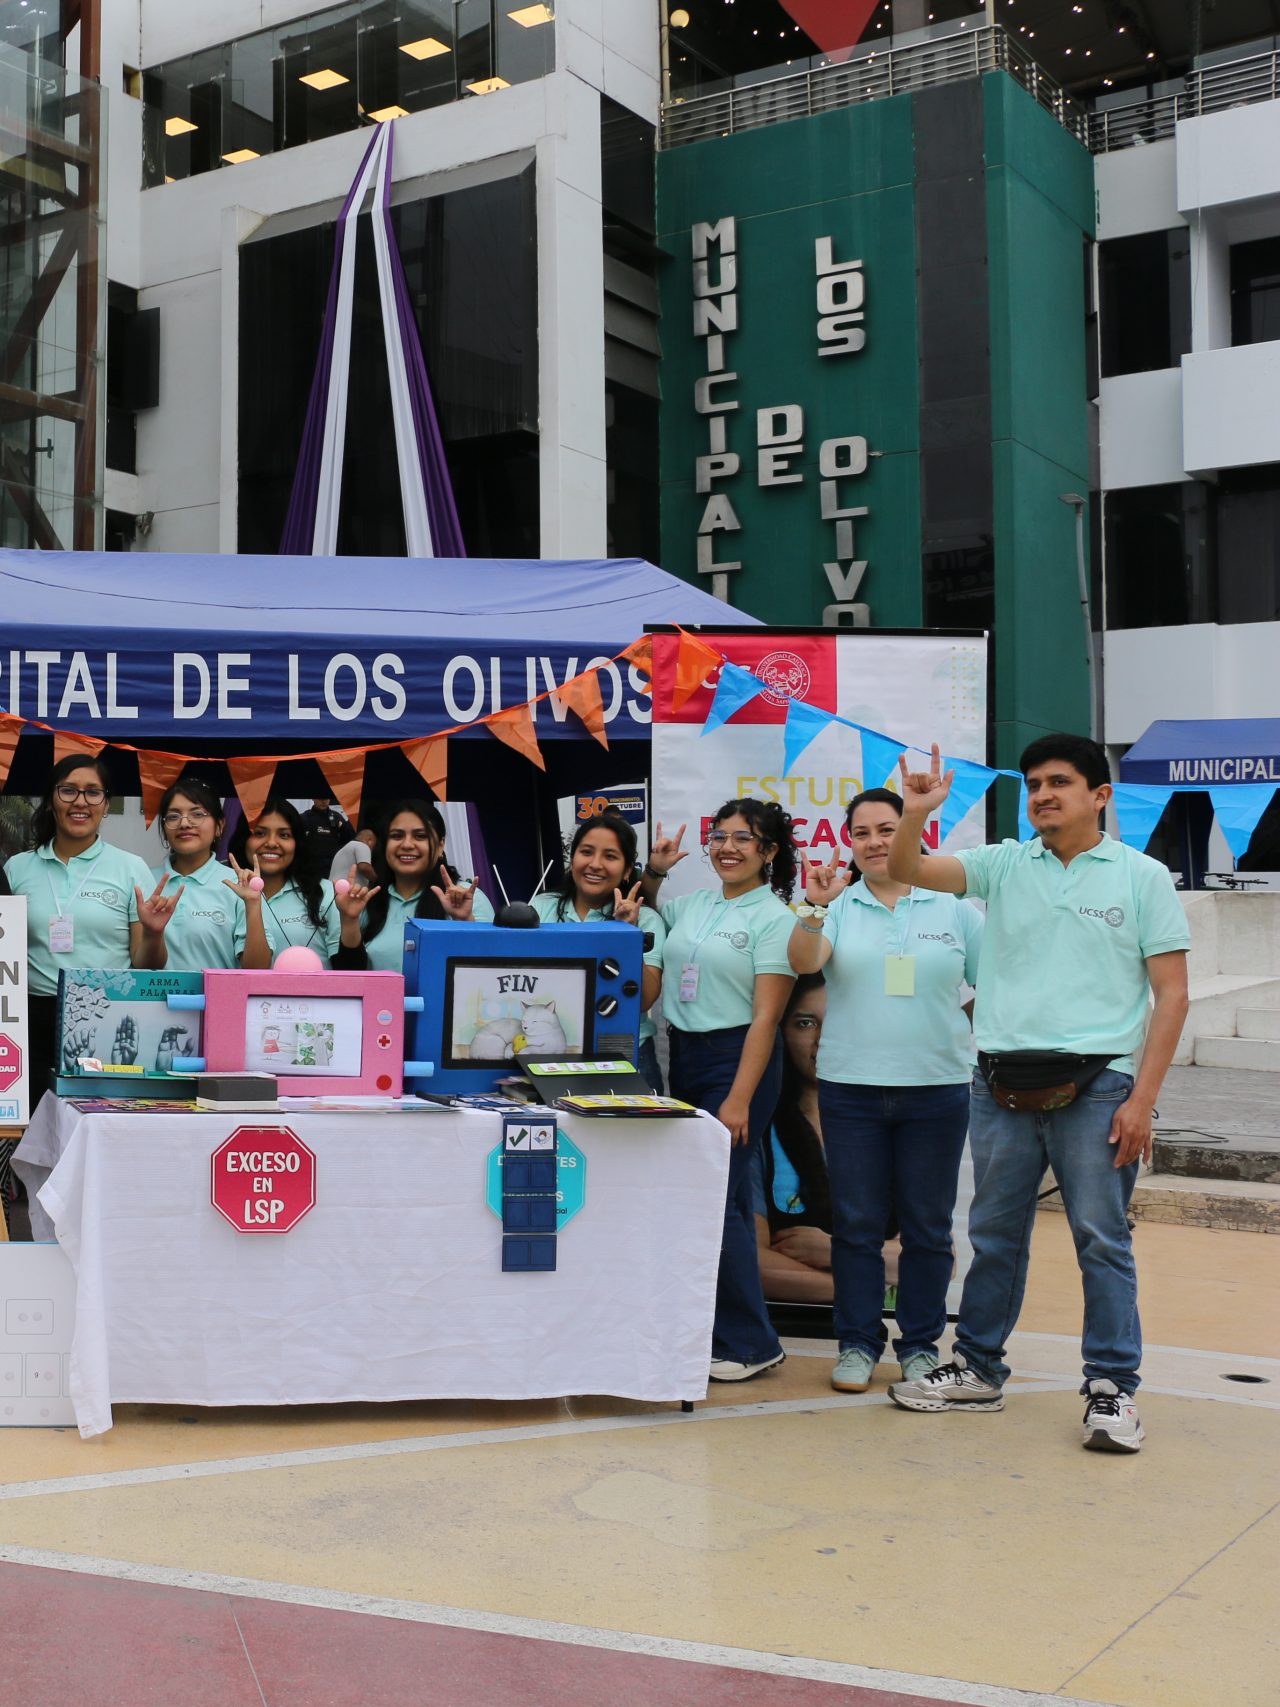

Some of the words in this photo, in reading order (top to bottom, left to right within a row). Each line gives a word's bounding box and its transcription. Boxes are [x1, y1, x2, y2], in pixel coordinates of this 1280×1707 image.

[815, 235, 866, 357] LOS
[757, 404, 803, 487] DE
[173, 652, 252, 719] DE
[288, 652, 406, 721] LOS
[442, 655, 652, 724] OLIVOS
[1169, 758, 1280, 781] MUNICIPAL
[577, 796, 608, 819] 30
[80, 891, 101, 899] UCSS
[1079, 906, 1104, 919] UCSS
[918, 933, 941, 941] UCSS
[149, 978, 180, 986] ARMA
[497, 974, 539, 994] FIN
[226, 1151, 300, 1173] EXCESO
[253, 1177, 273, 1193] EN
[244, 1199, 285, 1224] LSP
